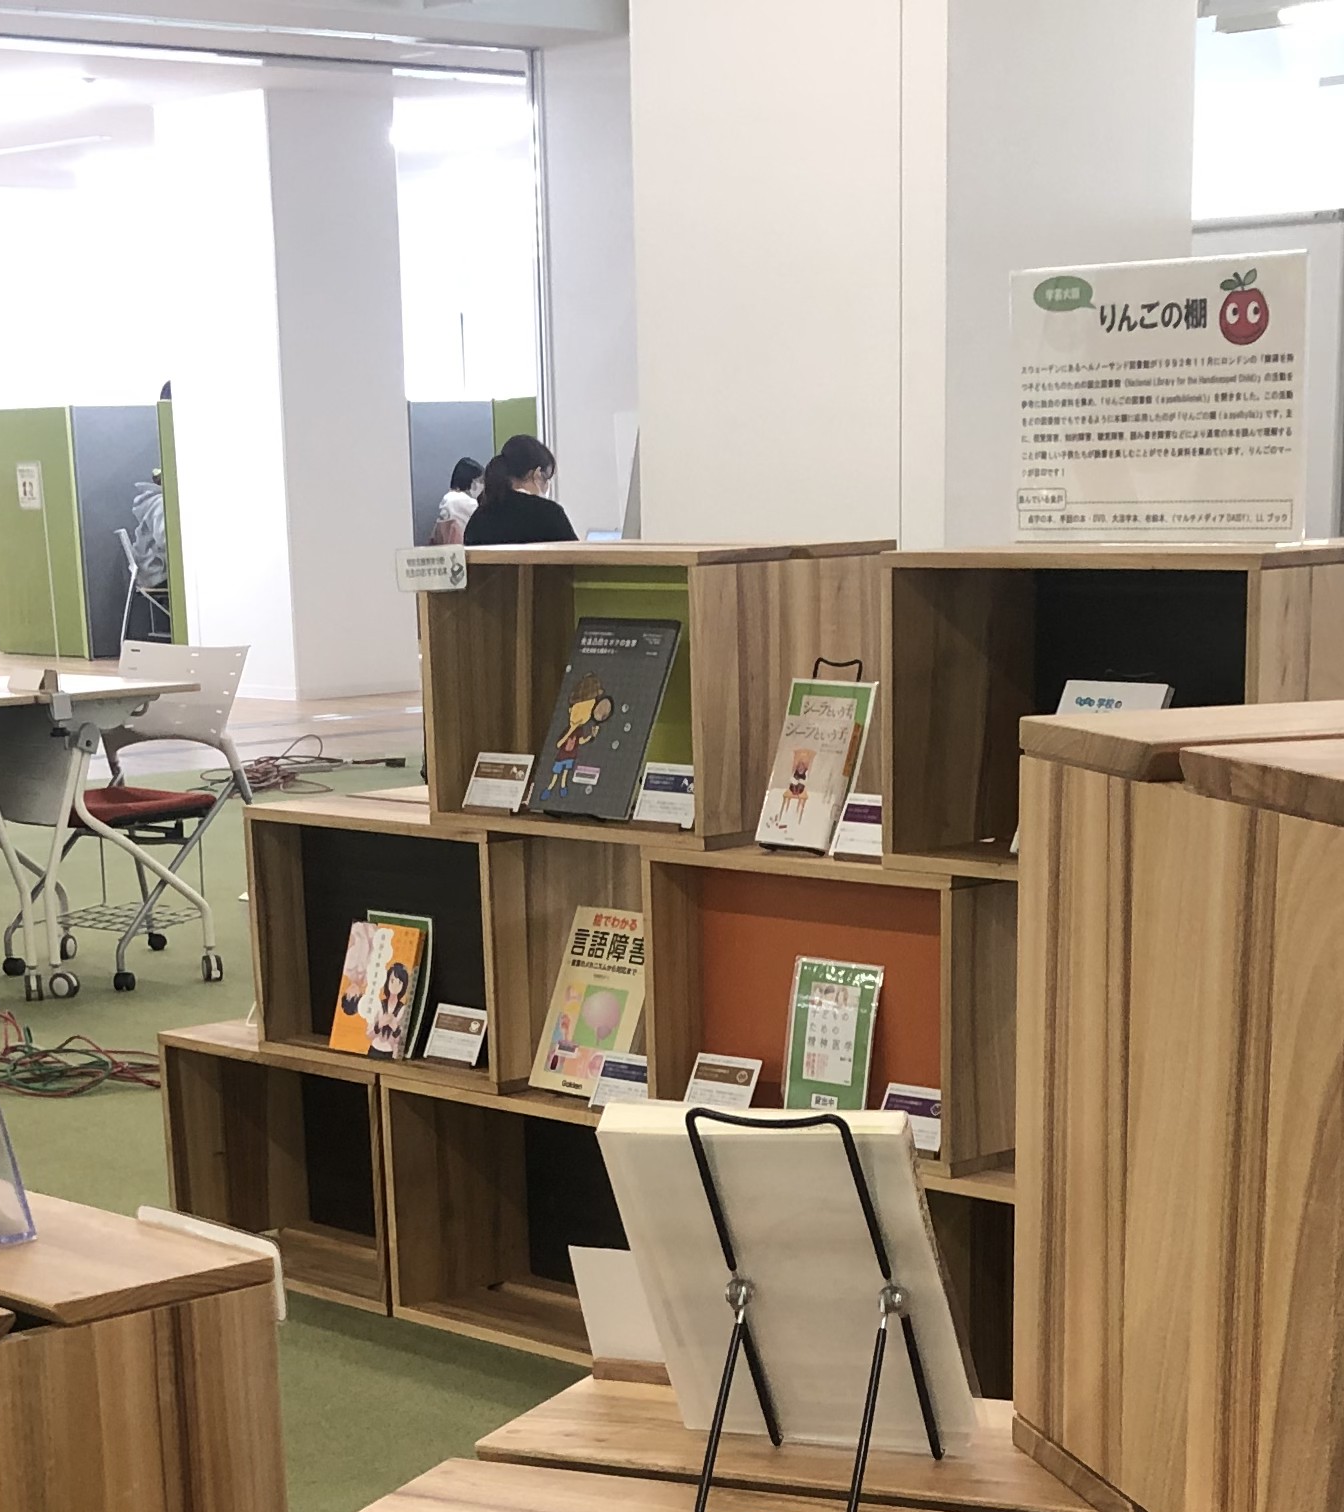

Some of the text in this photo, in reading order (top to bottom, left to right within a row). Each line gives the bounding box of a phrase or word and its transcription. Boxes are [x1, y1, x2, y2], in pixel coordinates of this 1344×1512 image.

[1099, 298, 1207, 333] りんごの棚
[571, 928, 645, 966] 言語障害
